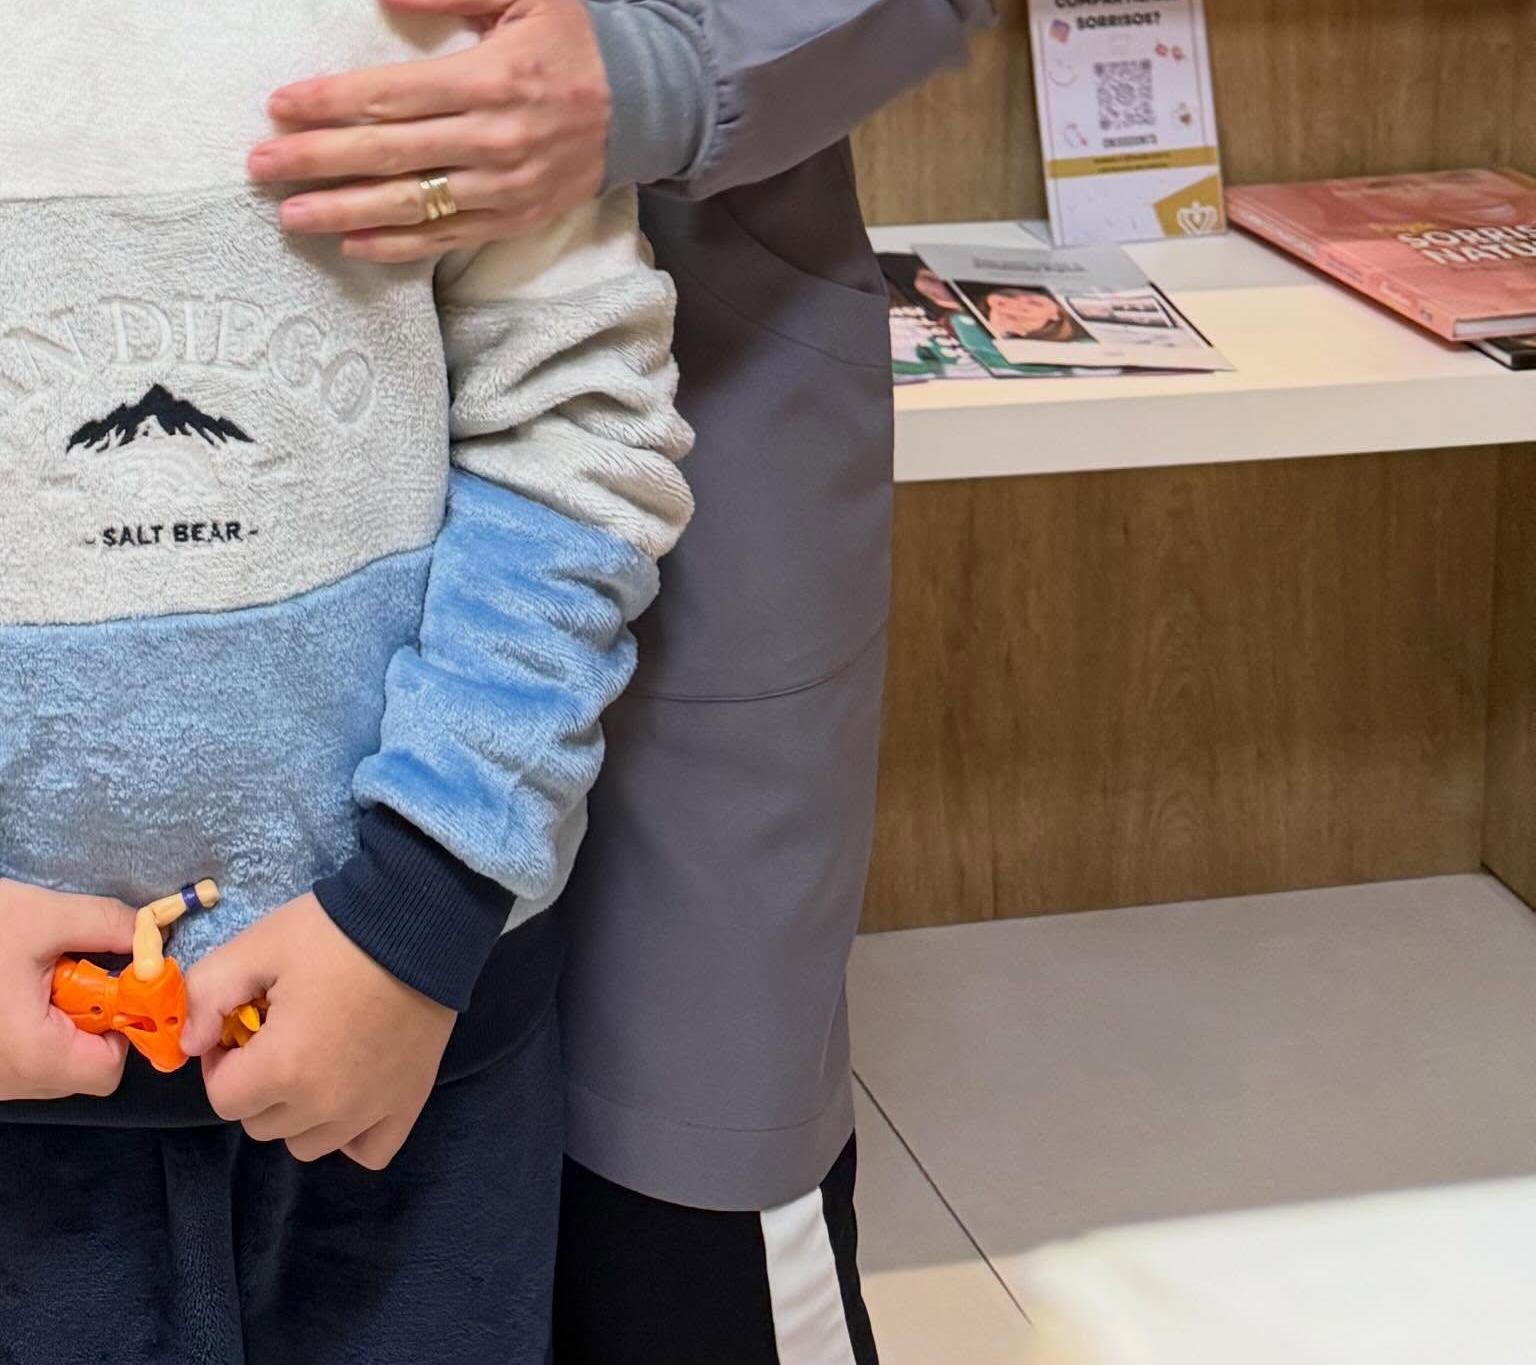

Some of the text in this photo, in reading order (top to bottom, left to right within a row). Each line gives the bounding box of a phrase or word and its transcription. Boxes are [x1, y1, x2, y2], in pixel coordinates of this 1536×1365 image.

[100, 294, 377, 425] DIEGO
[102, 519, 243, 547] SALT BEAR
